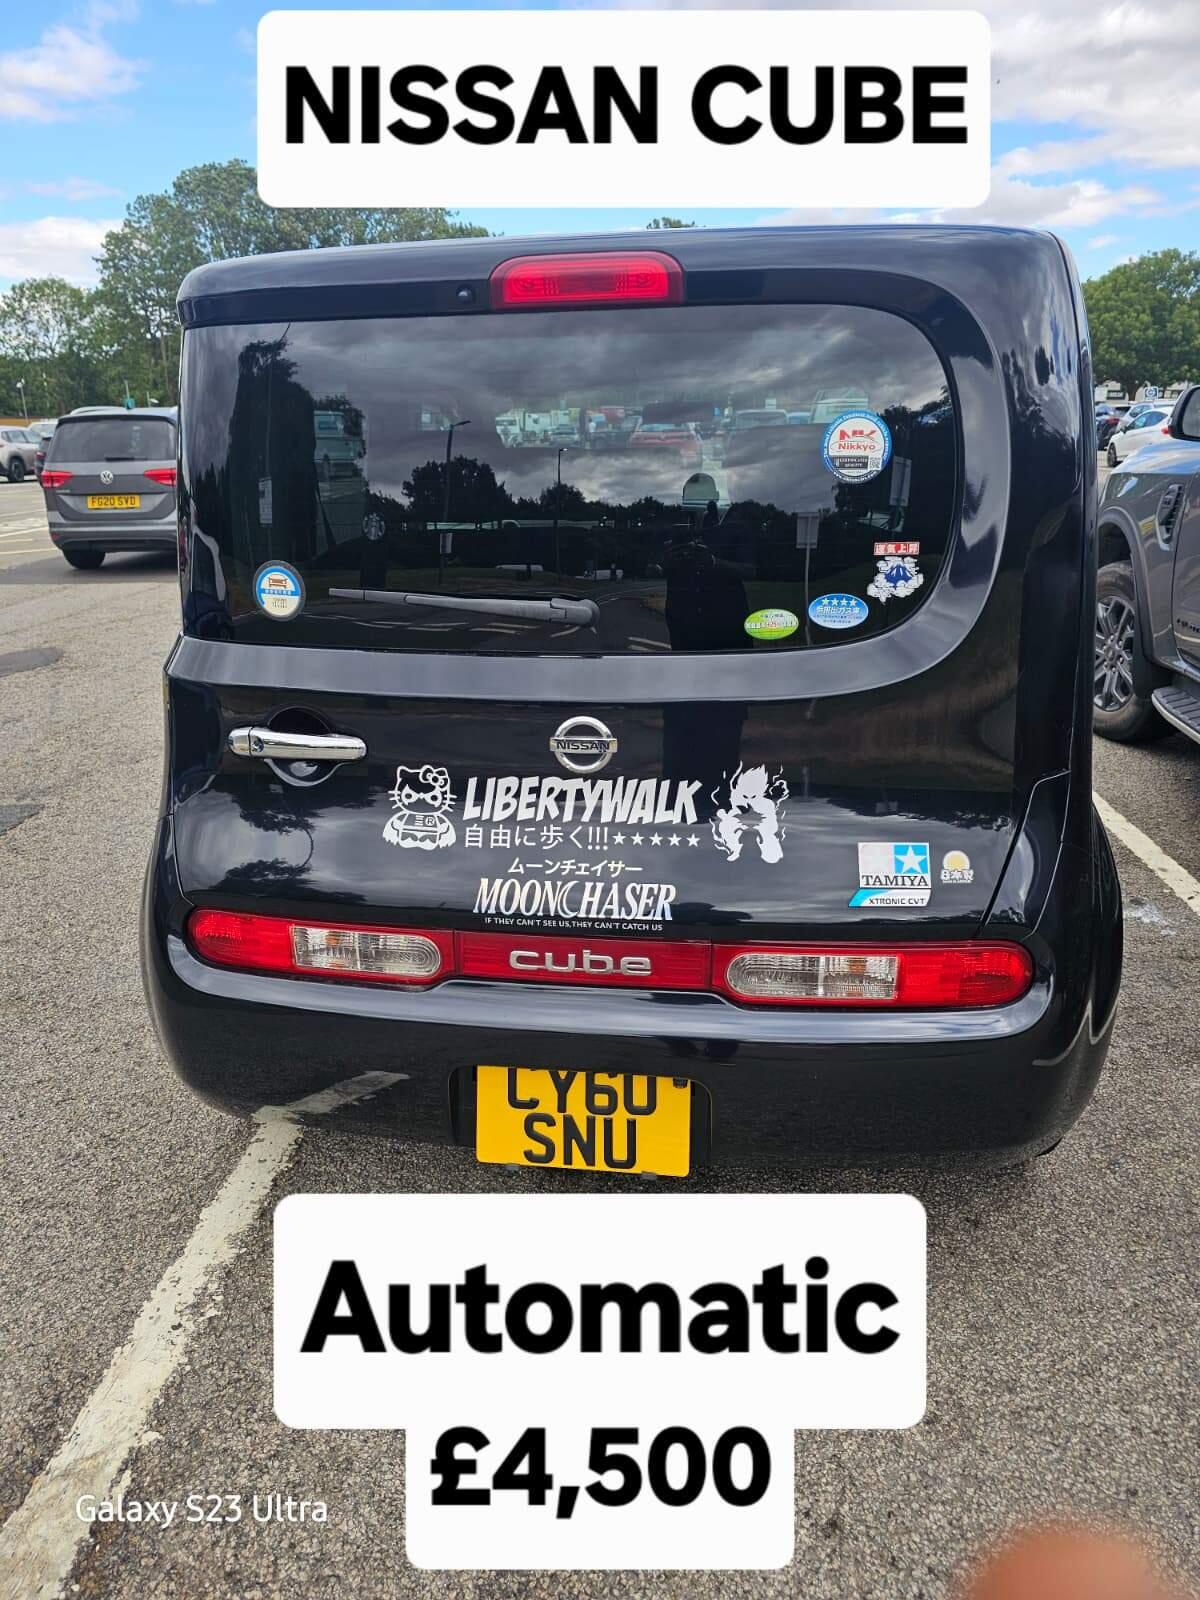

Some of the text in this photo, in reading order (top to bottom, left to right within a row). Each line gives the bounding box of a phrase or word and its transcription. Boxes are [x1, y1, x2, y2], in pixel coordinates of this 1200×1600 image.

[838, 442, 876, 452] Nikkyo
[91, 496, 136, 507] FG20 SVD
[556, 741, 610, 752] NISSAN
[463, 776, 703, 825] LIBERTYWALK
[507, 857, 644, 878] ムーンチェイサー
[861, 874, 929, 887] TAMIYA
[473, 877, 677, 921] MOONCHASER
[868, 897, 925, 905] XTRONIC CVT
[516, 919, 541, 927] CAN'T
[594, 921, 620, 929] CAN'T
[621, 922, 649, 930] CATCH
[651, 923, 663, 931] US
[509, 949, 652, 976] cube
[507, 1067, 657, 1116] CY60
[523, 1112, 637, 1170] SNU
